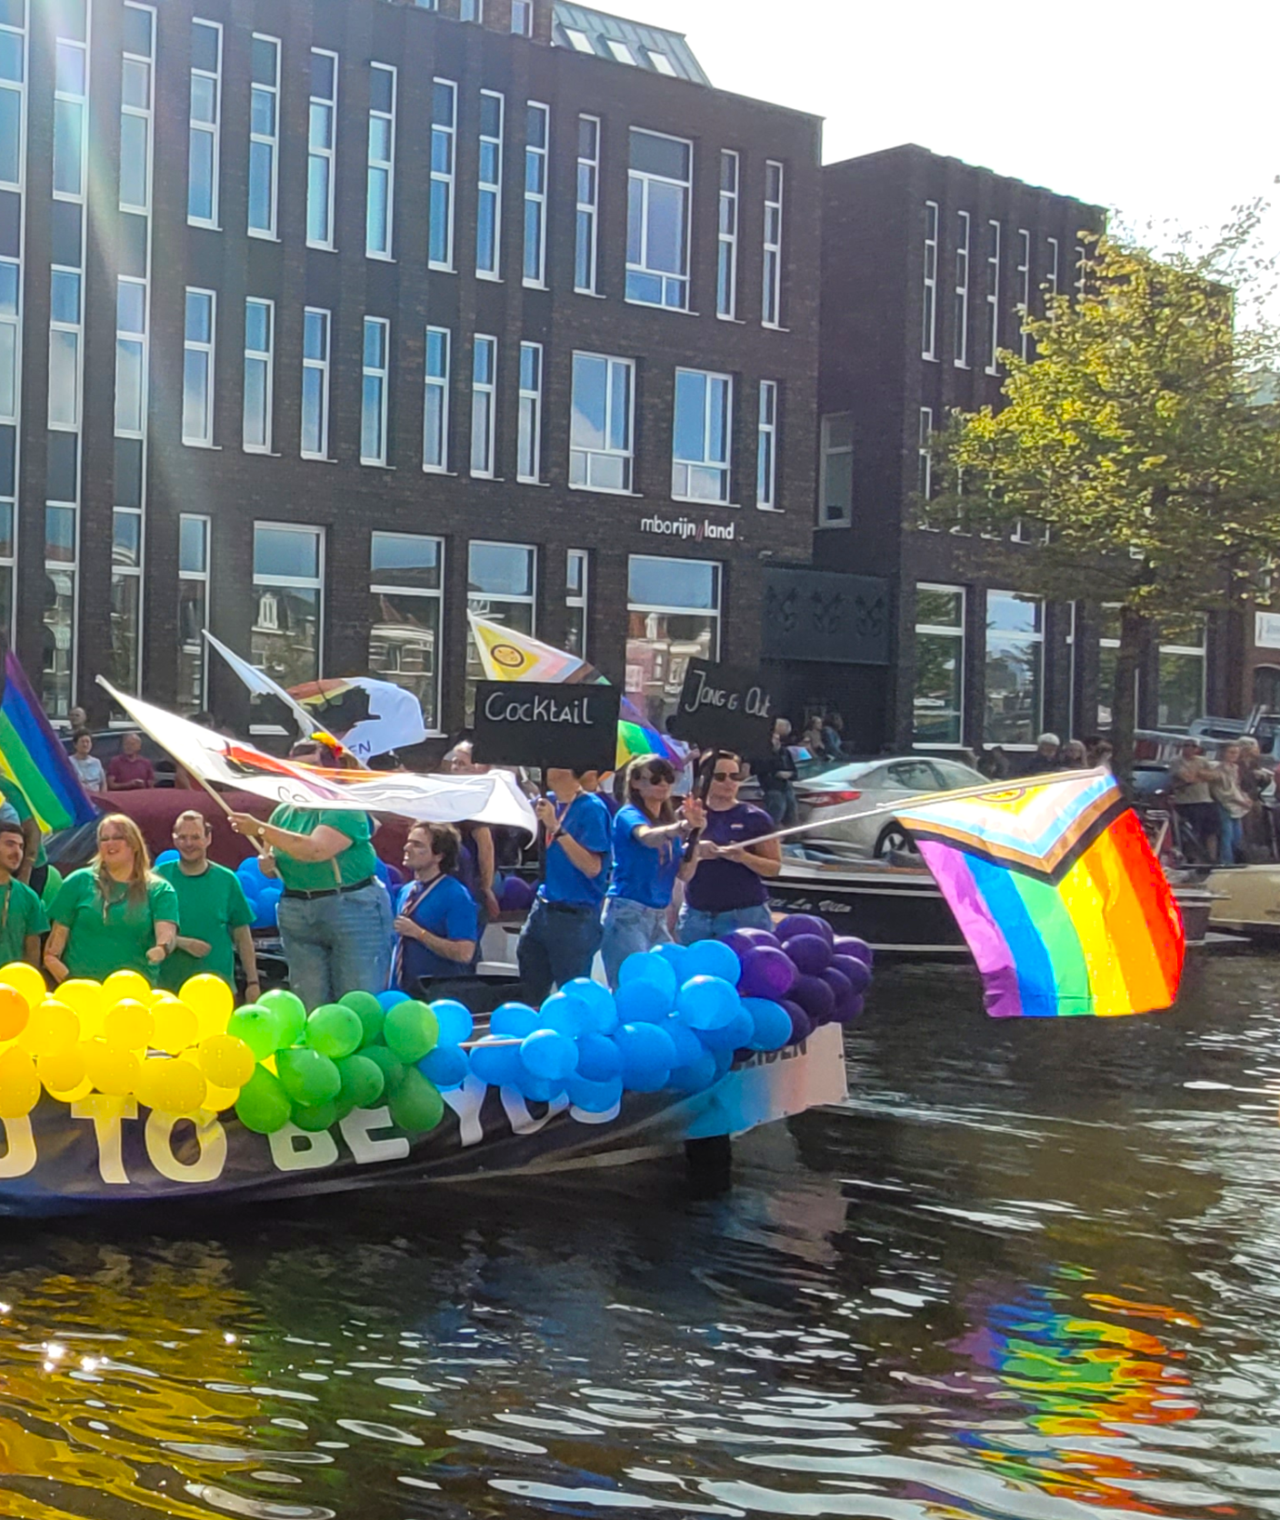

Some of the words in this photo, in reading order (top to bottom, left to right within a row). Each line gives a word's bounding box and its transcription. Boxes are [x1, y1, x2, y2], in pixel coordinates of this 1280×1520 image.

[70, 1094, 228, 1184] TO
[267, 1105, 410, 1172] BE
[439, 1073, 621, 1148] YO
